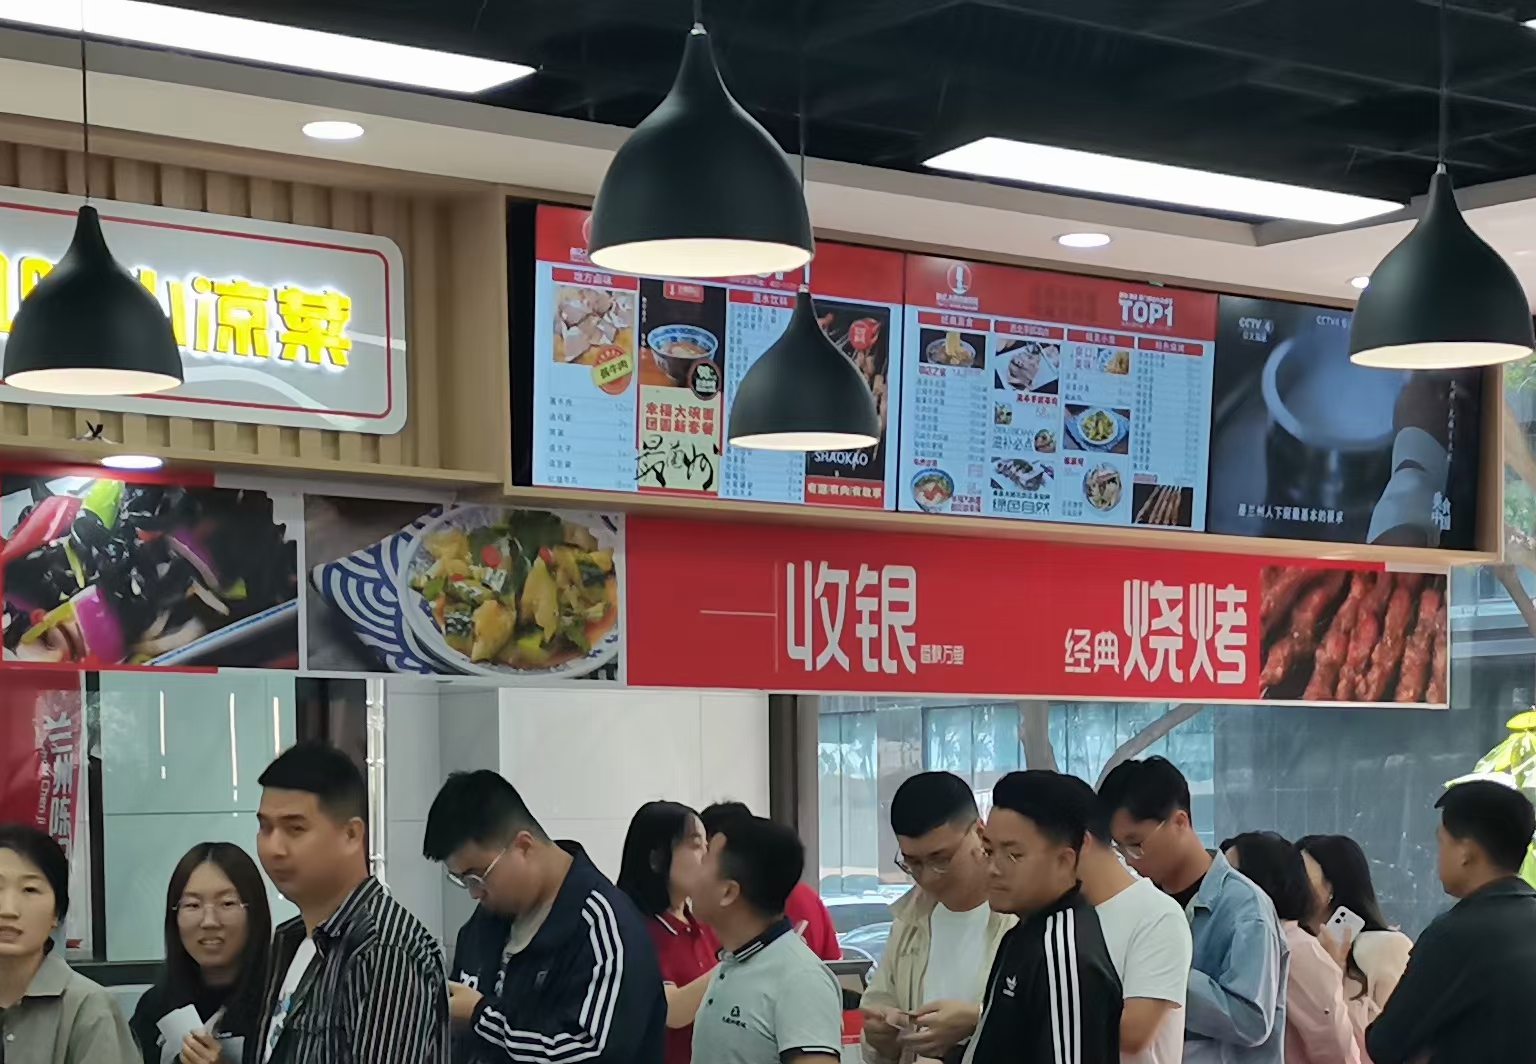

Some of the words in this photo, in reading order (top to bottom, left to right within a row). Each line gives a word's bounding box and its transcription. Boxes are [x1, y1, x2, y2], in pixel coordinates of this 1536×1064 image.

[1120, 299, 1173, 327] TOP1
[814, 450, 869, 468] SHAOKAO
[784, 559, 917, 675] 收银
